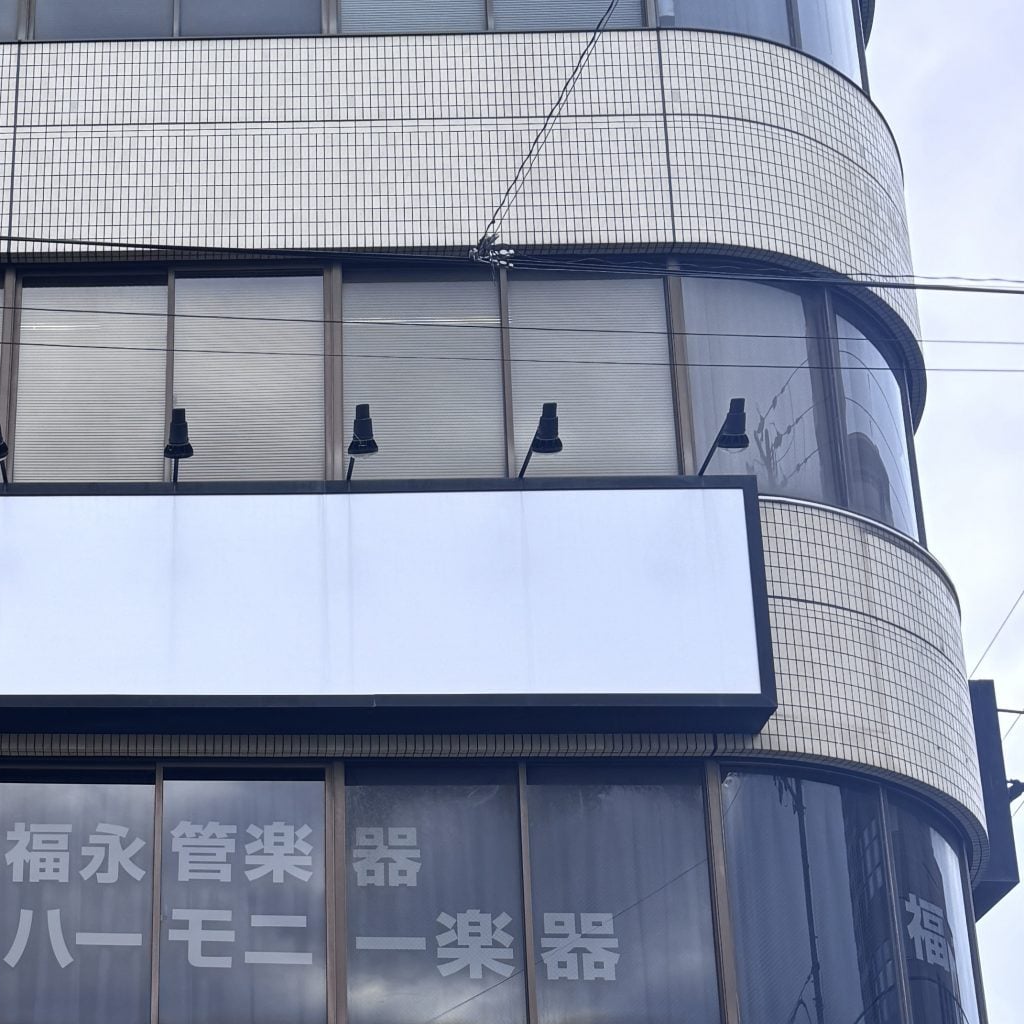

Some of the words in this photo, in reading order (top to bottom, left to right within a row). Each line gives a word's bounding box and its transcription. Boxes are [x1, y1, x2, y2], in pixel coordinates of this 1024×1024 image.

[3, 820, 422, 888] 福永管楽器
[3, 908, 621, 981] ハーモニー楽器
